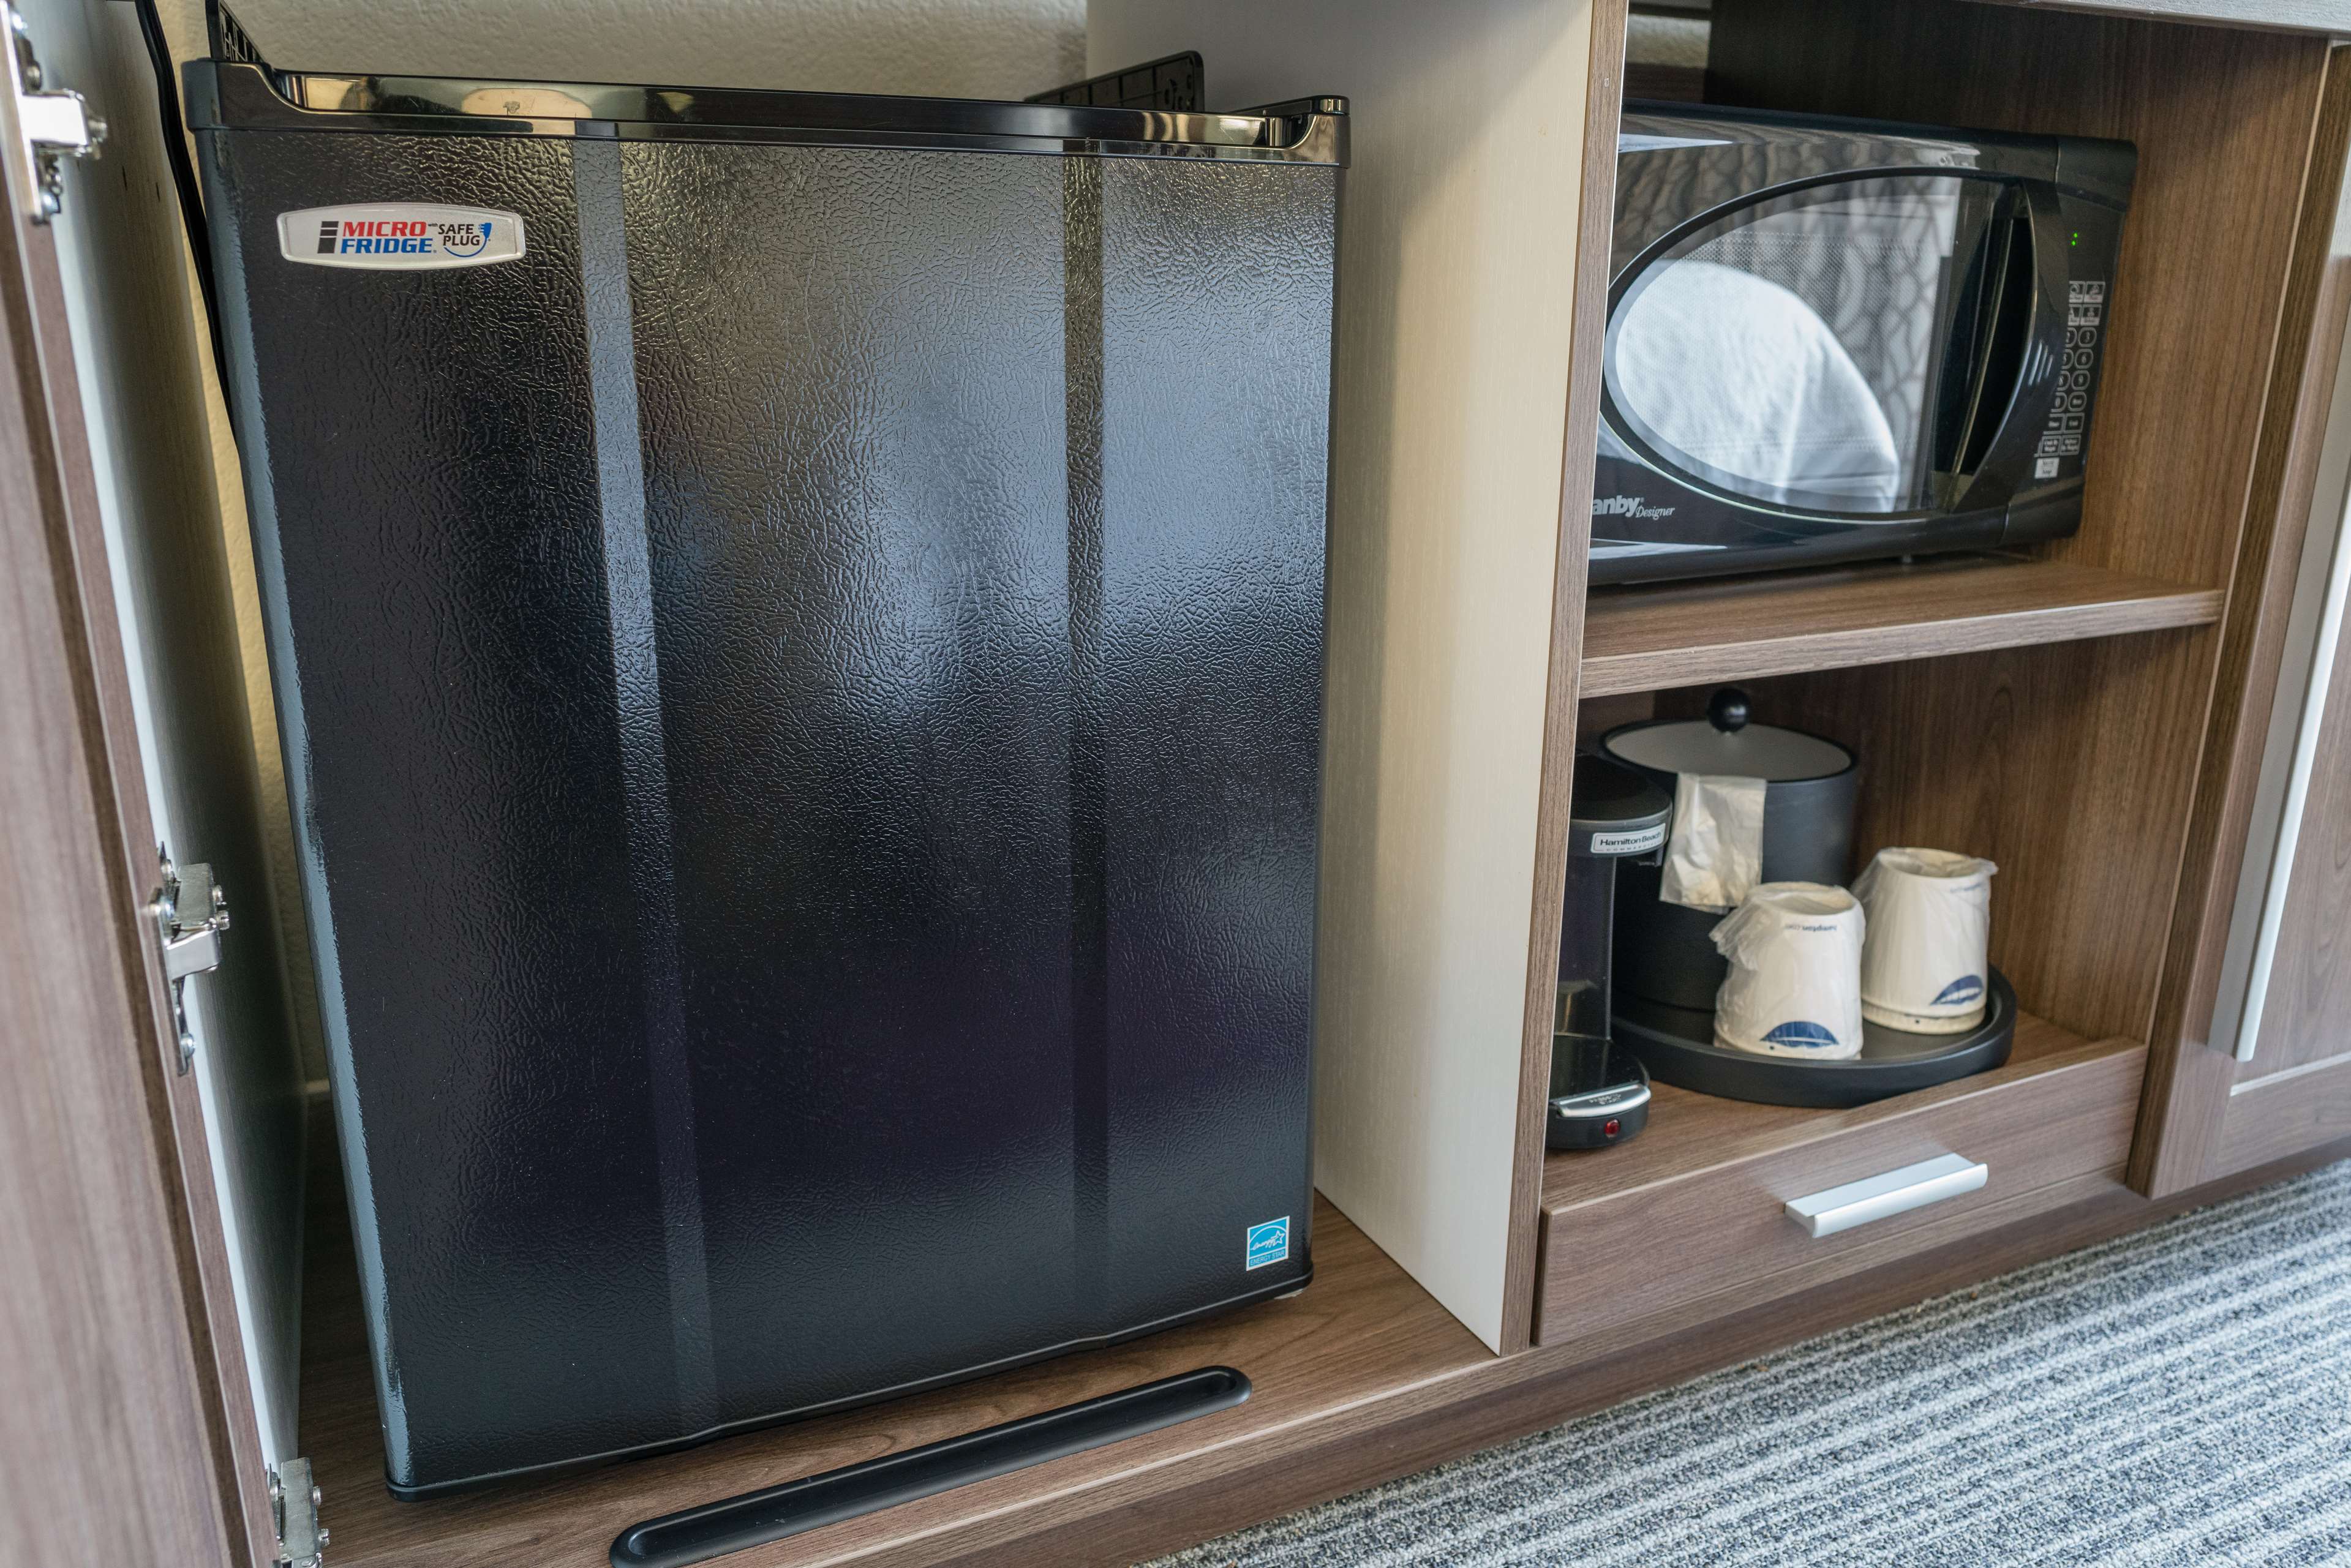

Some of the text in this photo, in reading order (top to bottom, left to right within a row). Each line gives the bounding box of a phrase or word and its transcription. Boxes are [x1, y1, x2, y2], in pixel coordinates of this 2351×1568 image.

[343, 221, 427, 236] MICRO
[438, 224, 474, 234] SAFE
[340, 238, 433, 253] FRIDGE
[443, 235, 480, 246] PLUG
[1593, 495, 1675, 520] anby Designer
[1600, 832, 1661, 846] Hamilton Beach
[1271, 1250, 1285, 1259] STAR
